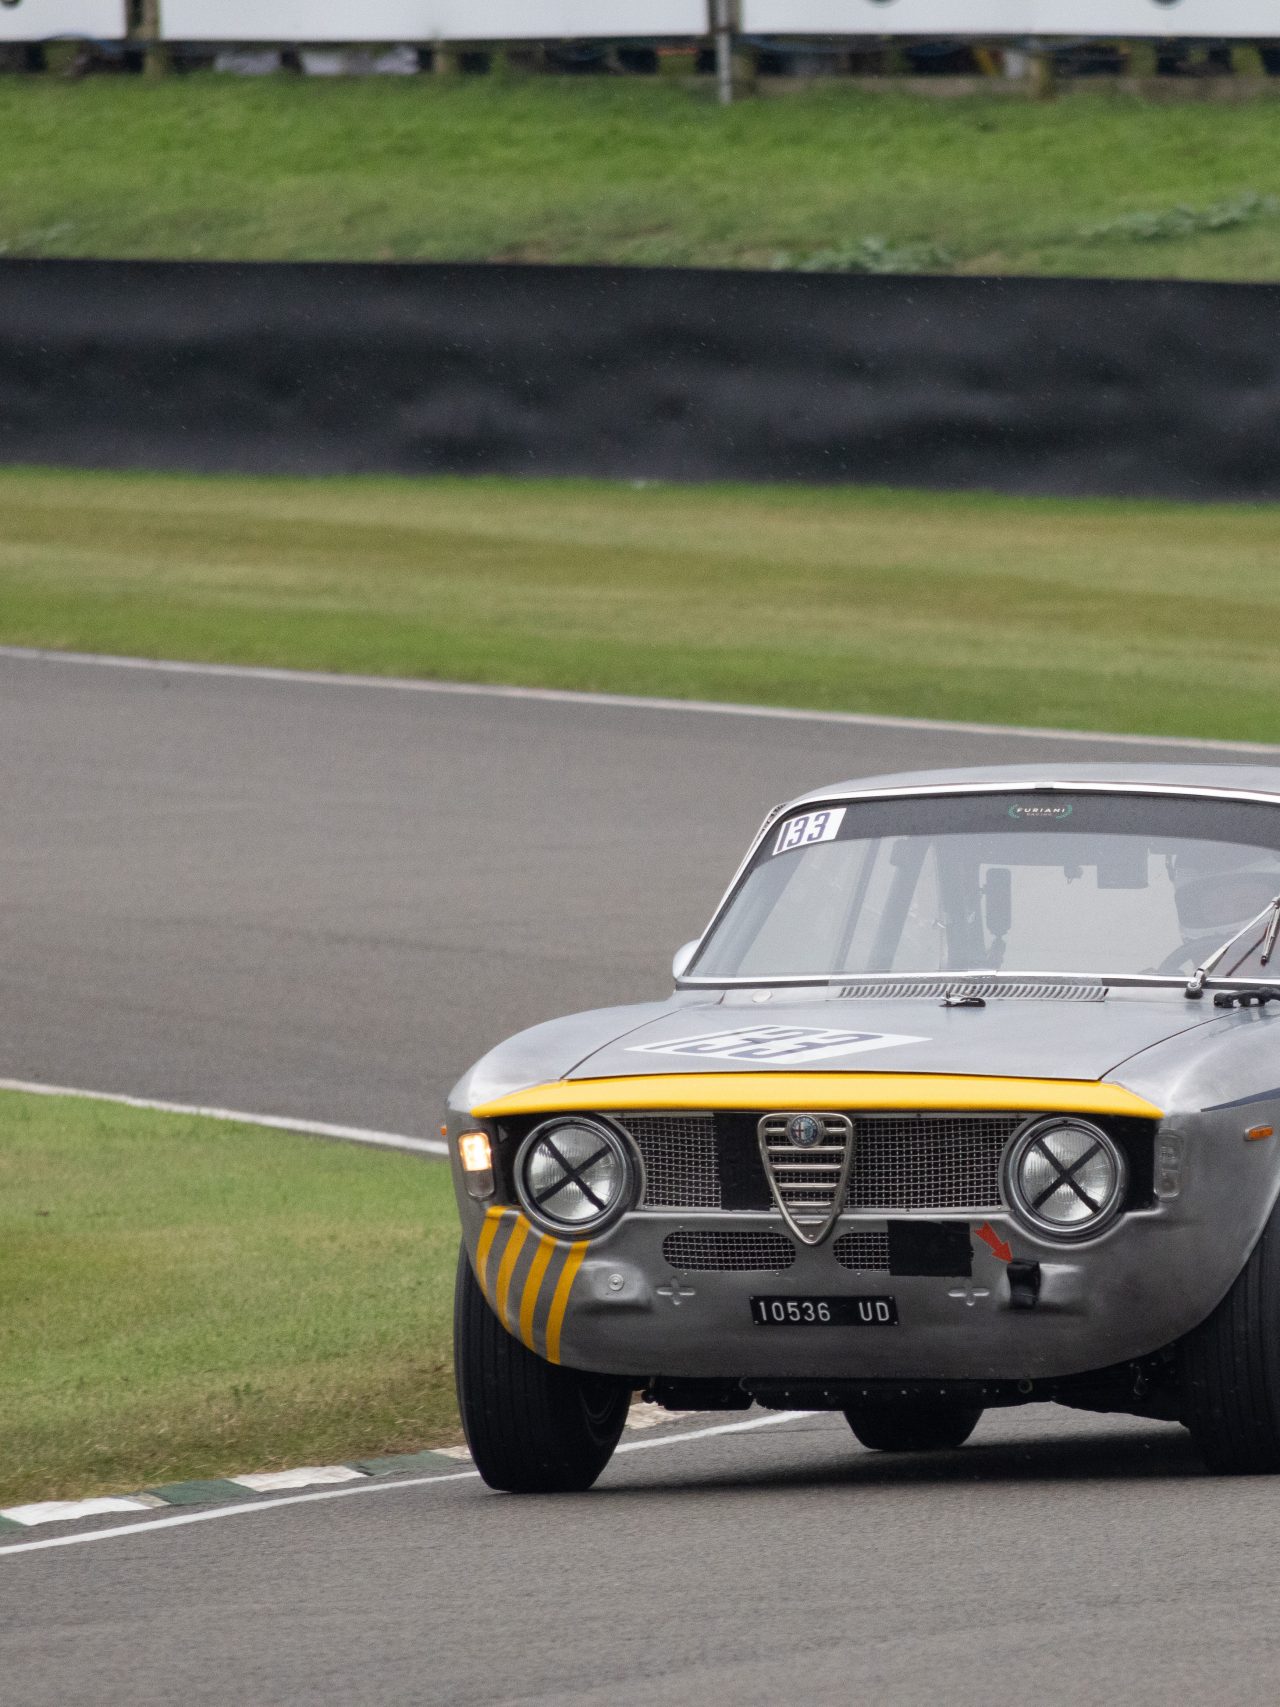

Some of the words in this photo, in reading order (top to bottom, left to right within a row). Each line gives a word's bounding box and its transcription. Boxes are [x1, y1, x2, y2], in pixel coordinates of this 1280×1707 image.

[776, 812, 831, 852] 133
[643, 1026, 884, 1059] 133
[759, 1301, 831, 1322] 10536
[858, 1301, 890, 1322] UD
